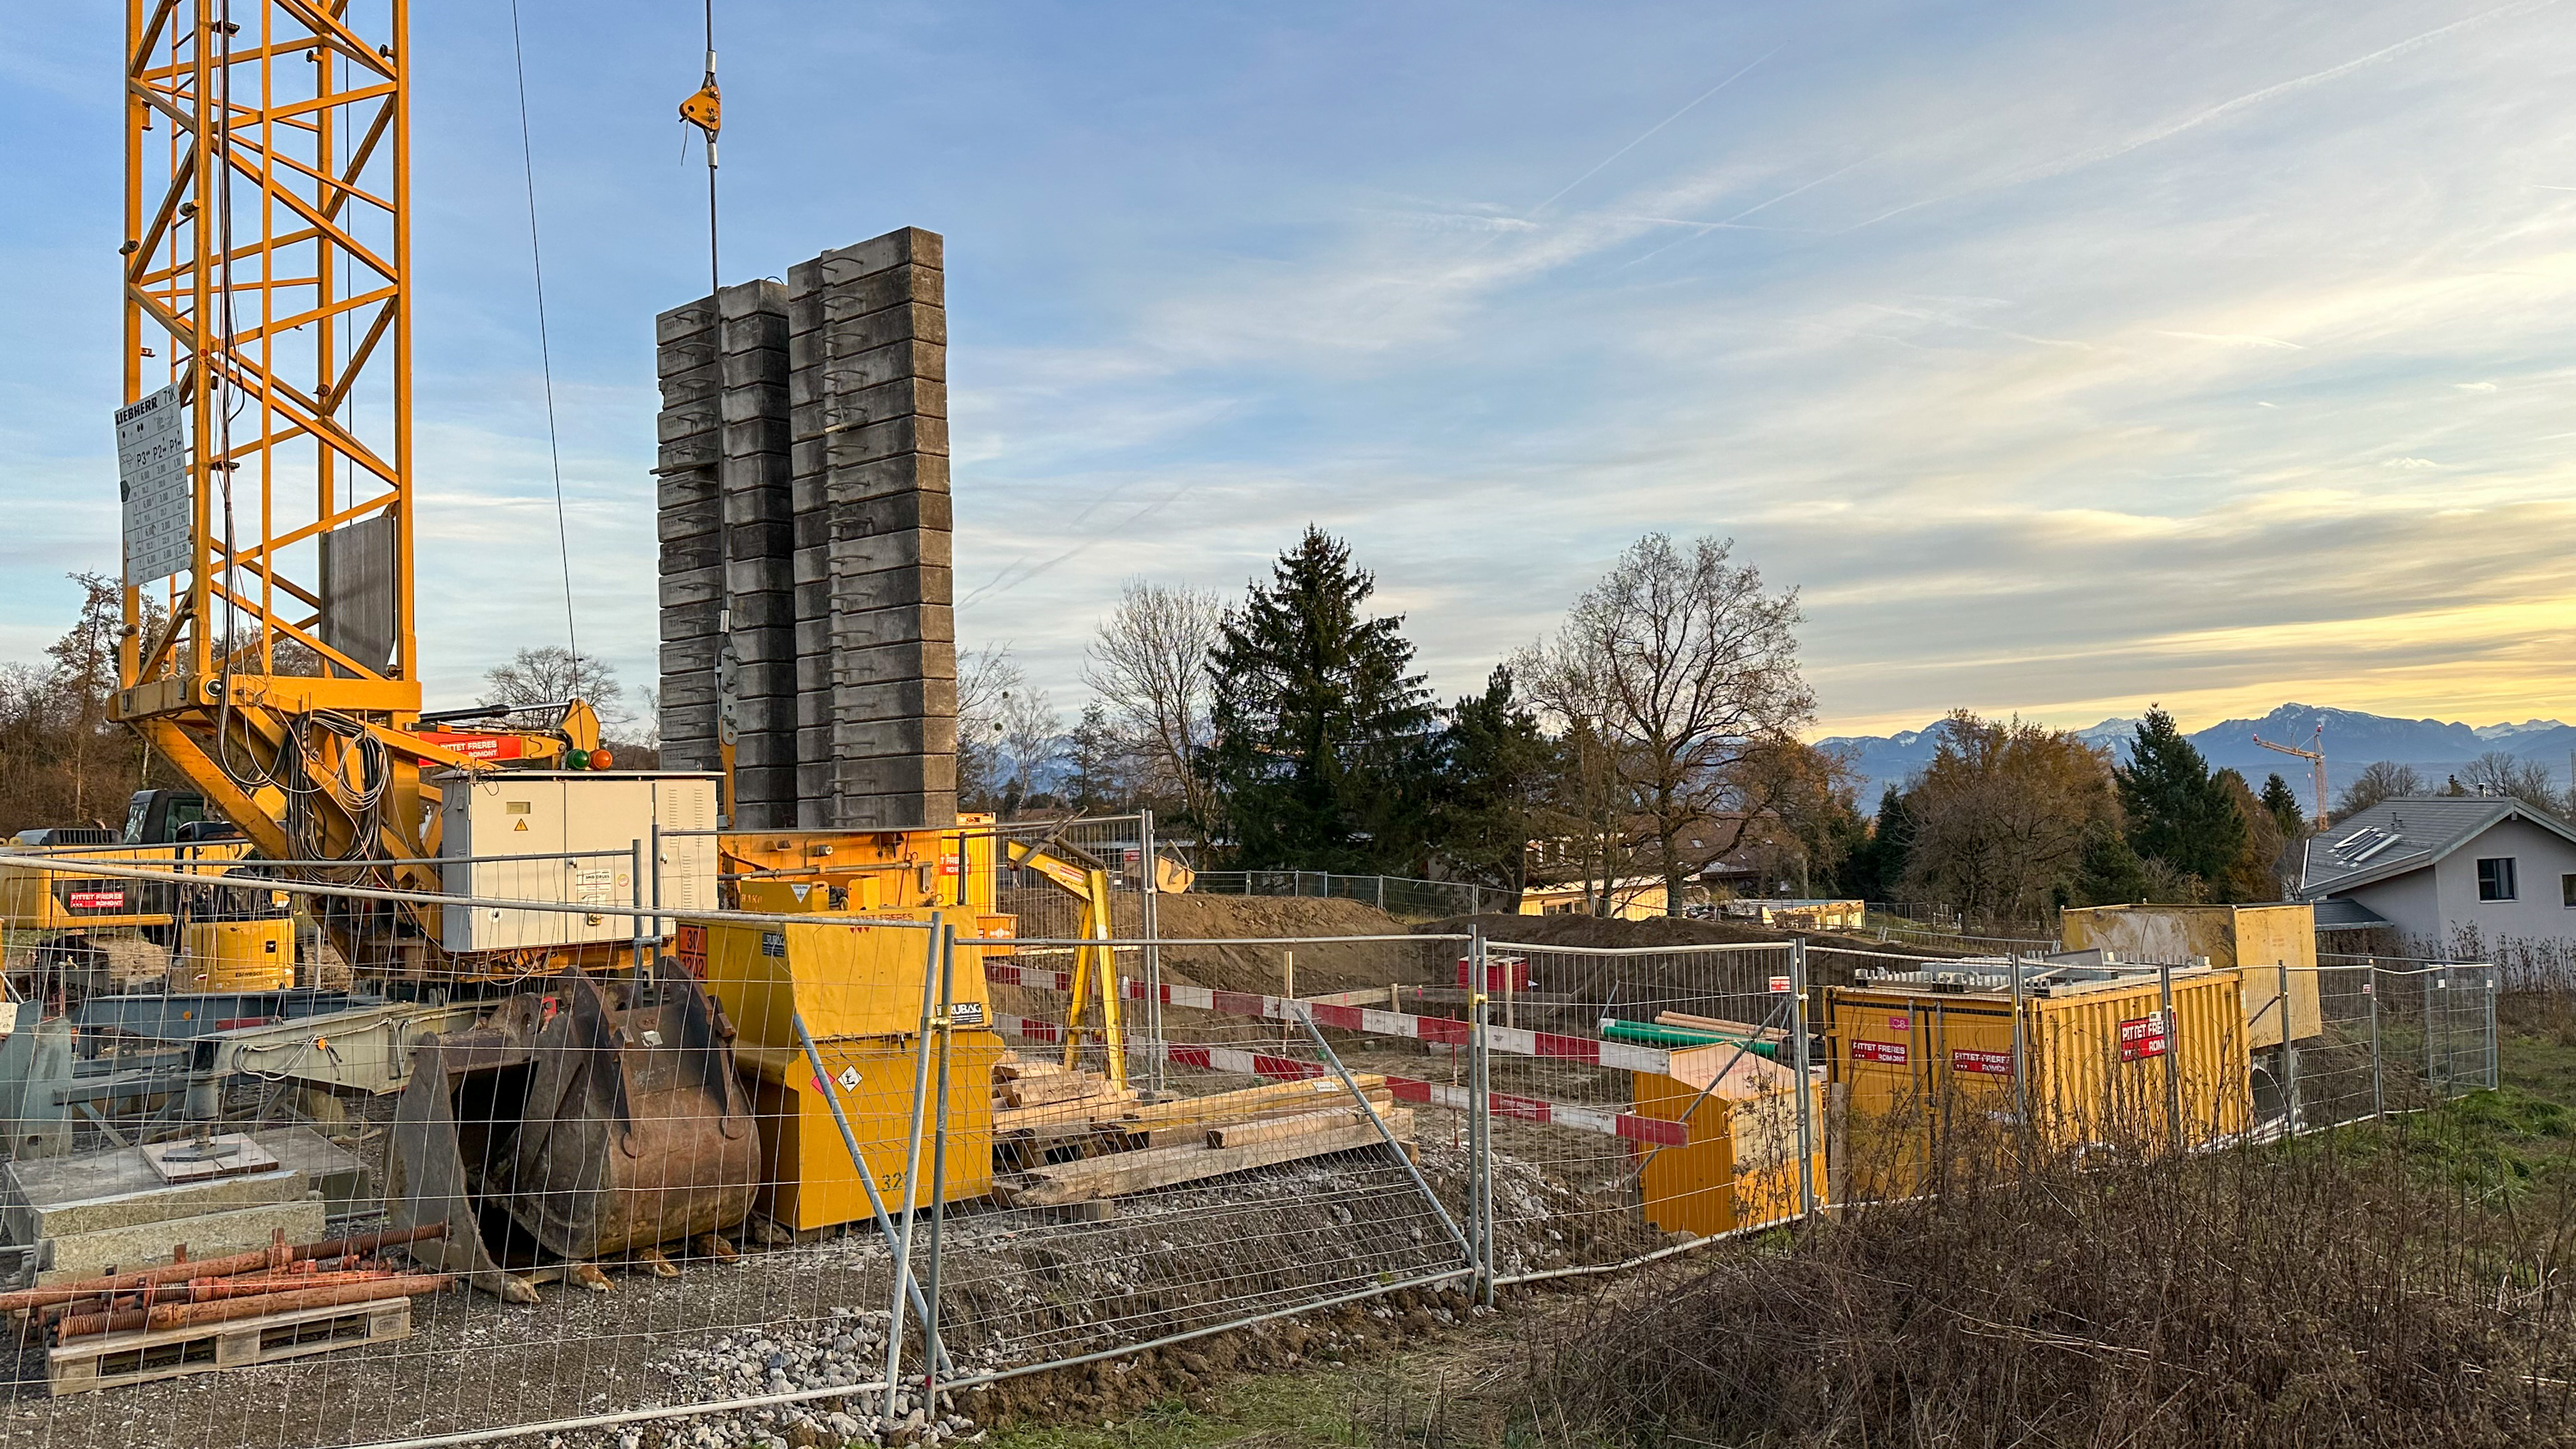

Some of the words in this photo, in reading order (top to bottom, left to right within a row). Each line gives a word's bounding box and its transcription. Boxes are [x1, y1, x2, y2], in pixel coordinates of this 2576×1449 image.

[115, 397, 158, 425] LIEBHERR
[163, 385, 176, 404] 71K
[137, 452, 147, 467] P3
[153, 445, 163, 460] P2
[169, 437, 179, 453] P1
[468, 741, 497, 749] FRERES
[468, 749, 497, 758] ROMONT
[687, 930, 698, 949] 30
[2122, 1024, 2147, 1041] PITTET
[1853, 1042, 1876, 1051] PITTET
[1878, 1045, 1905, 1054] FRERES
[1954, 1052, 1979, 1062] PITTET
[881, 1171, 908, 1192] 32
